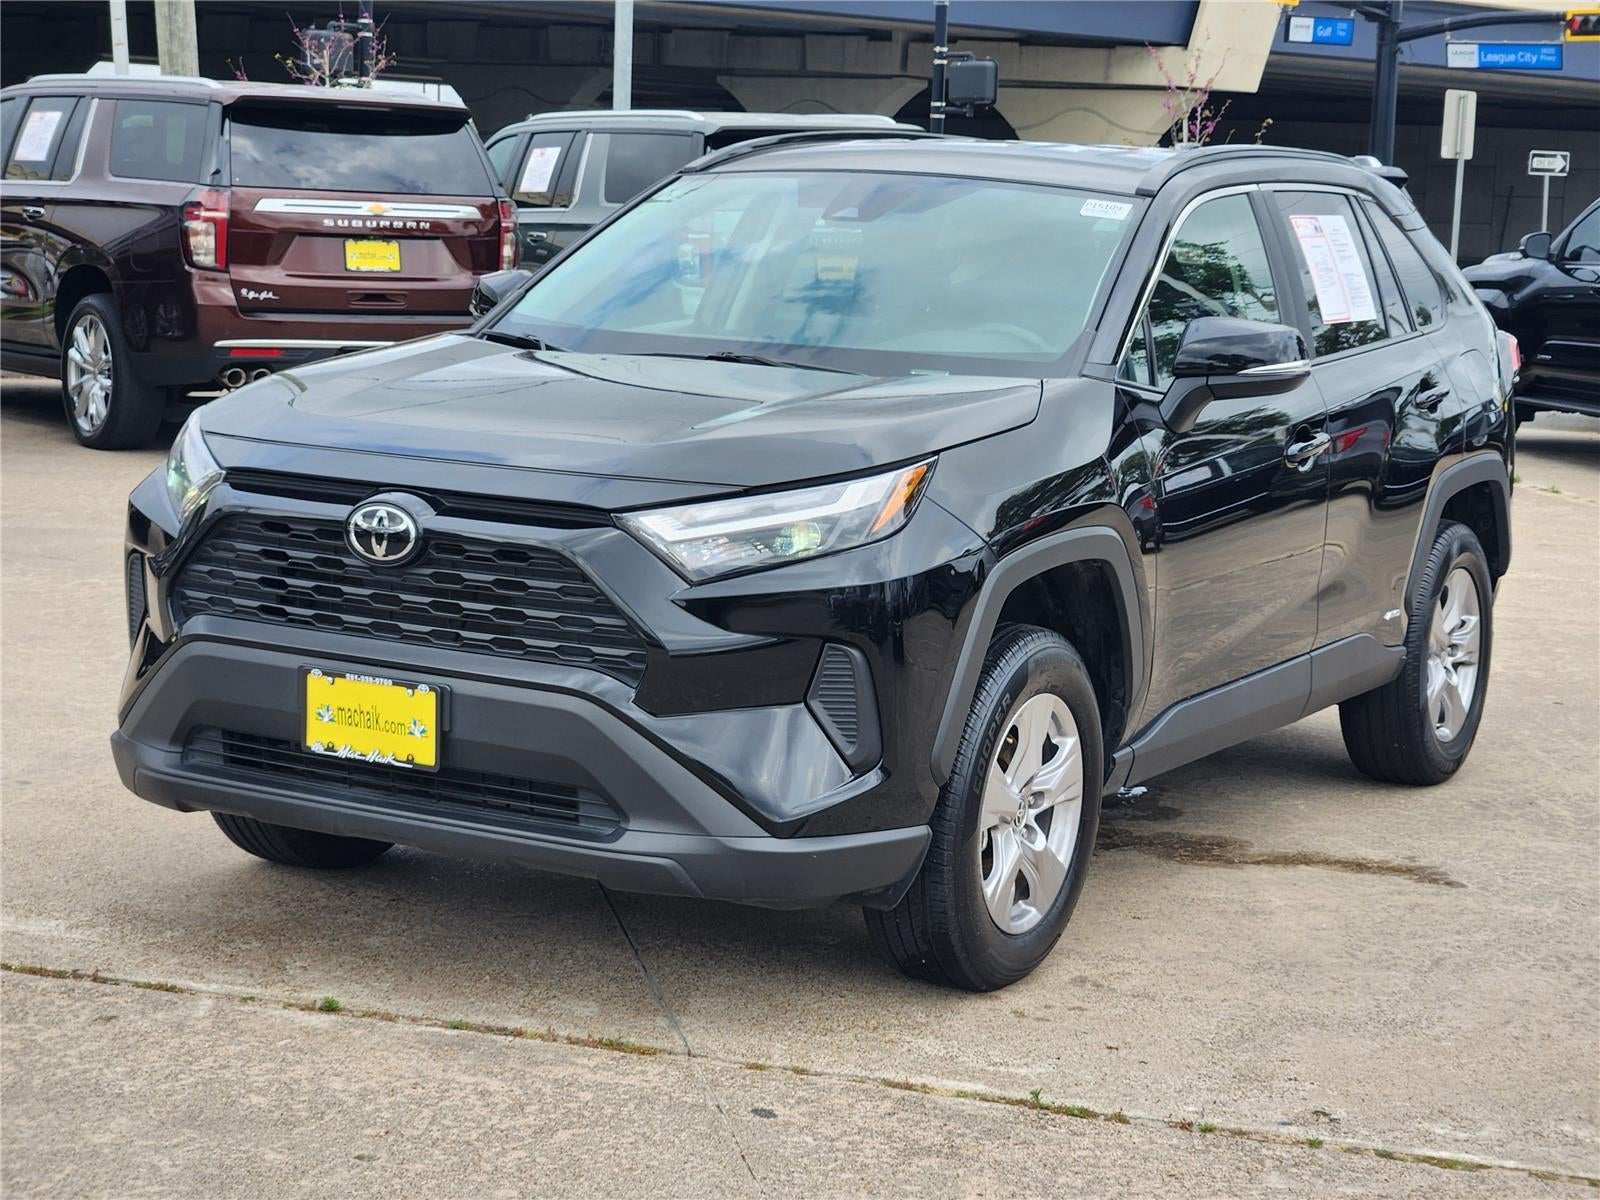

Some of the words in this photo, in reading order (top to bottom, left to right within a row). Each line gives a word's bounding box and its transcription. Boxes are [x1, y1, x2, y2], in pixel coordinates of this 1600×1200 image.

[1317, 25, 1333, 37] Gulf
[1480, 51, 1517, 65] League
[1517, 51, 1538, 64] City
[322, 217, 431, 230] SUBURBAN
[336, 703, 407, 737] machaik.com
[973, 692, 1011, 795] COOPER
[337, 743, 365, 759] Mac
[365, 748, 398, 764] Haik
